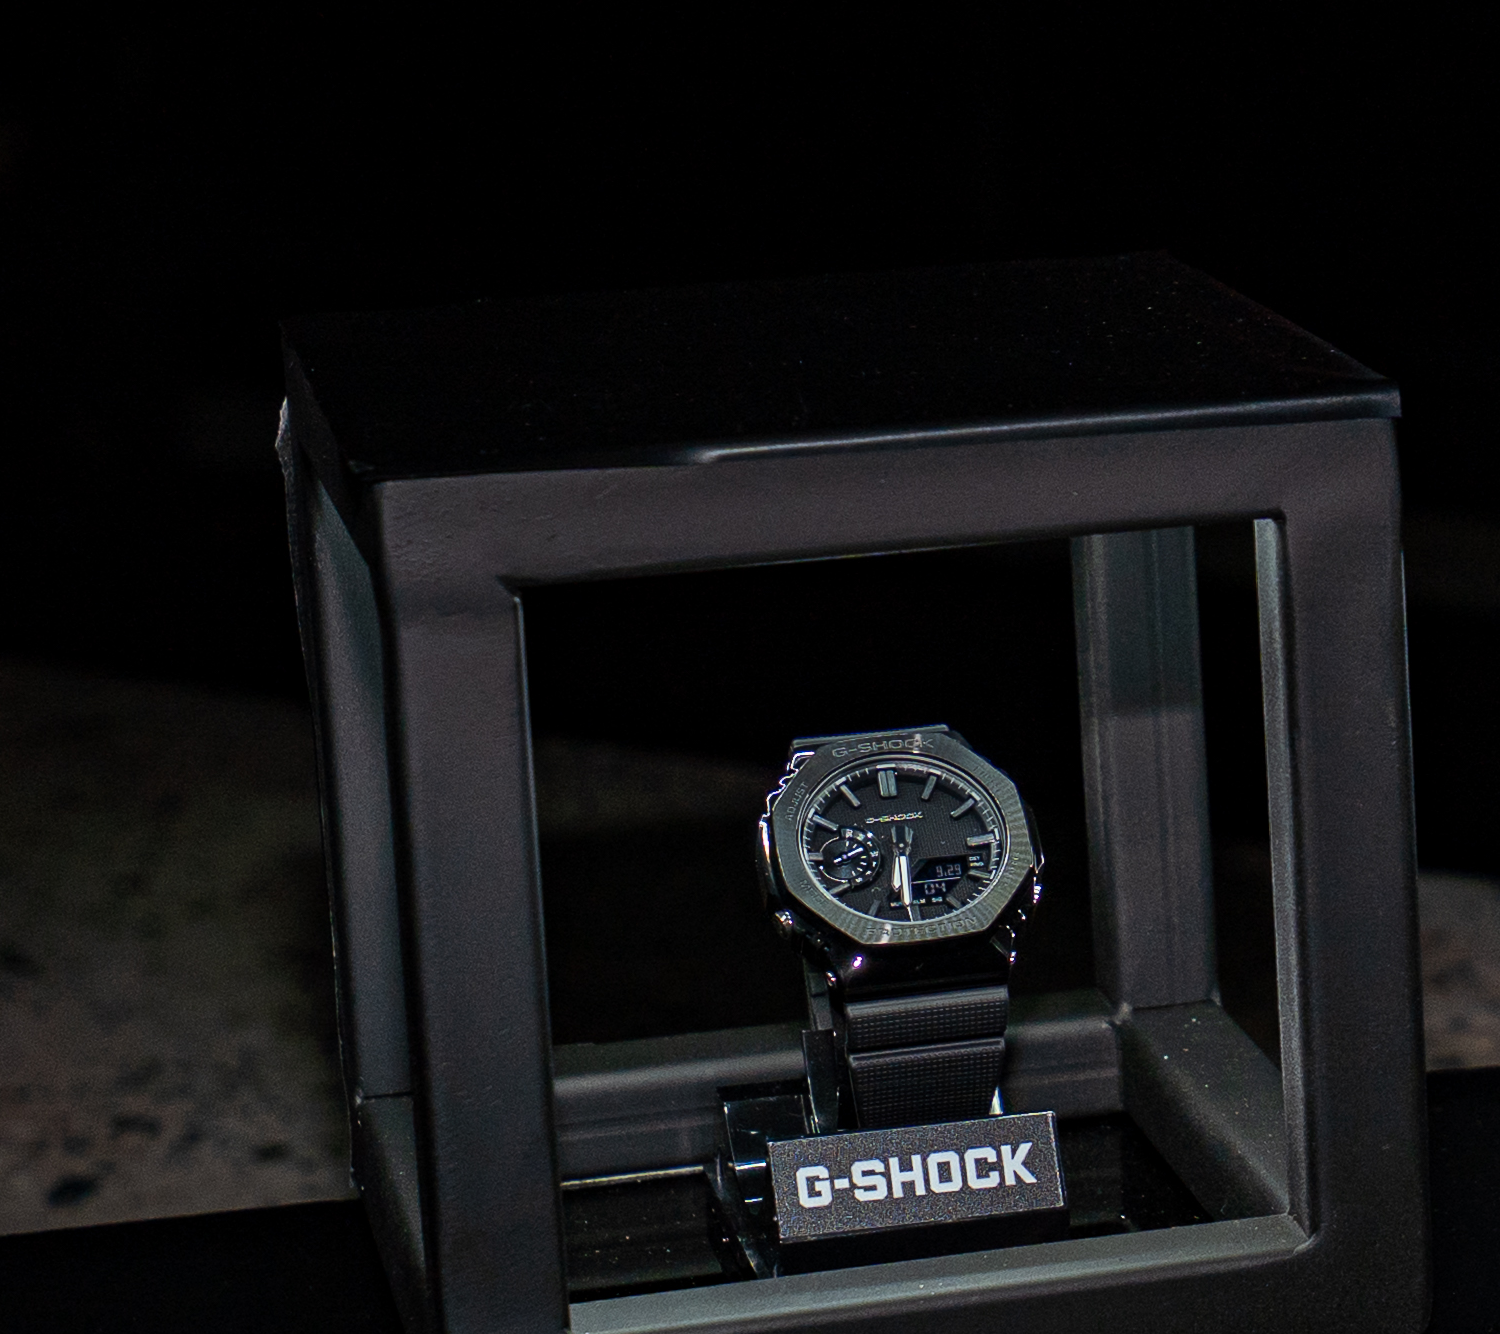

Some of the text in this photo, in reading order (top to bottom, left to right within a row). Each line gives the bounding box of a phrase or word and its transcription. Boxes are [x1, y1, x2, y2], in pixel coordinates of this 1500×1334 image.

[832, 738, 934, 758] G-SHOCK
[785, 781, 809, 821] ADJUST
[796, 1142, 1038, 1208] G-SHOCK
